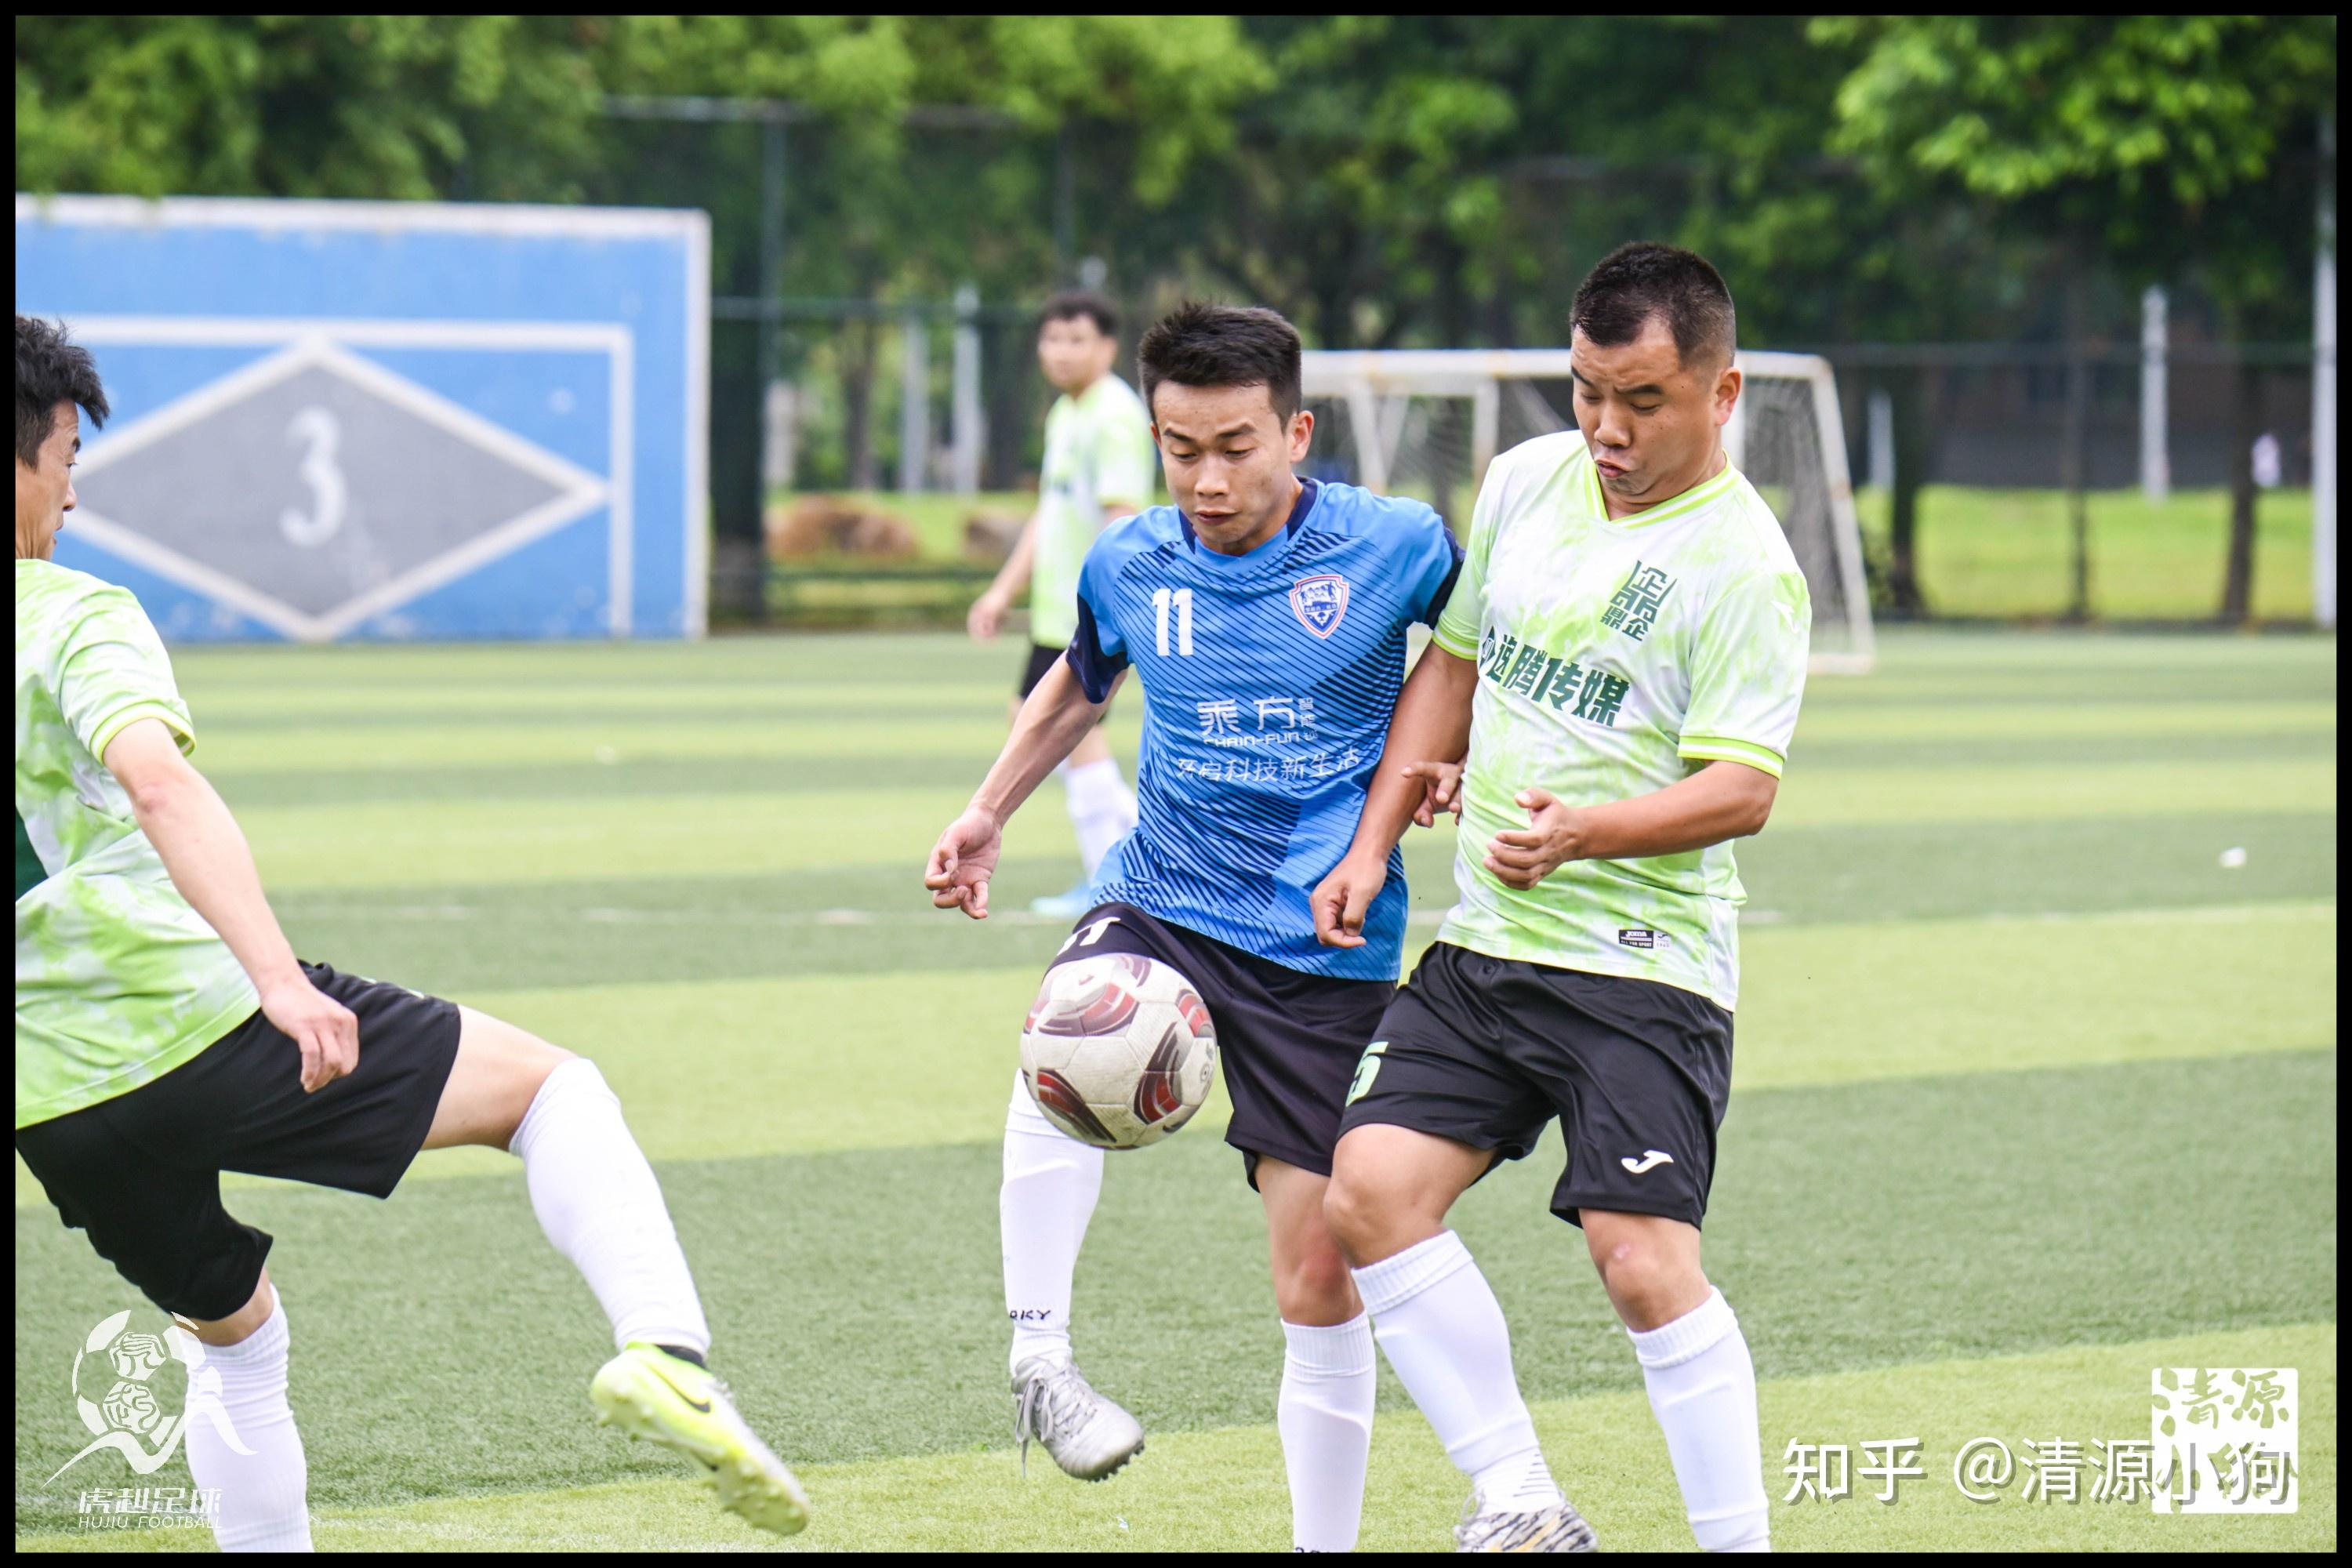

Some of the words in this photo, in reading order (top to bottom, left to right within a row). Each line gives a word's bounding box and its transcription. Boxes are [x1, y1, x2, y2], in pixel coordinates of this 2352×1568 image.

[278, 406, 349, 546] 3
[1152, 587, 1193, 657] 11
[1196, 695, 1296, 735] 乘方
